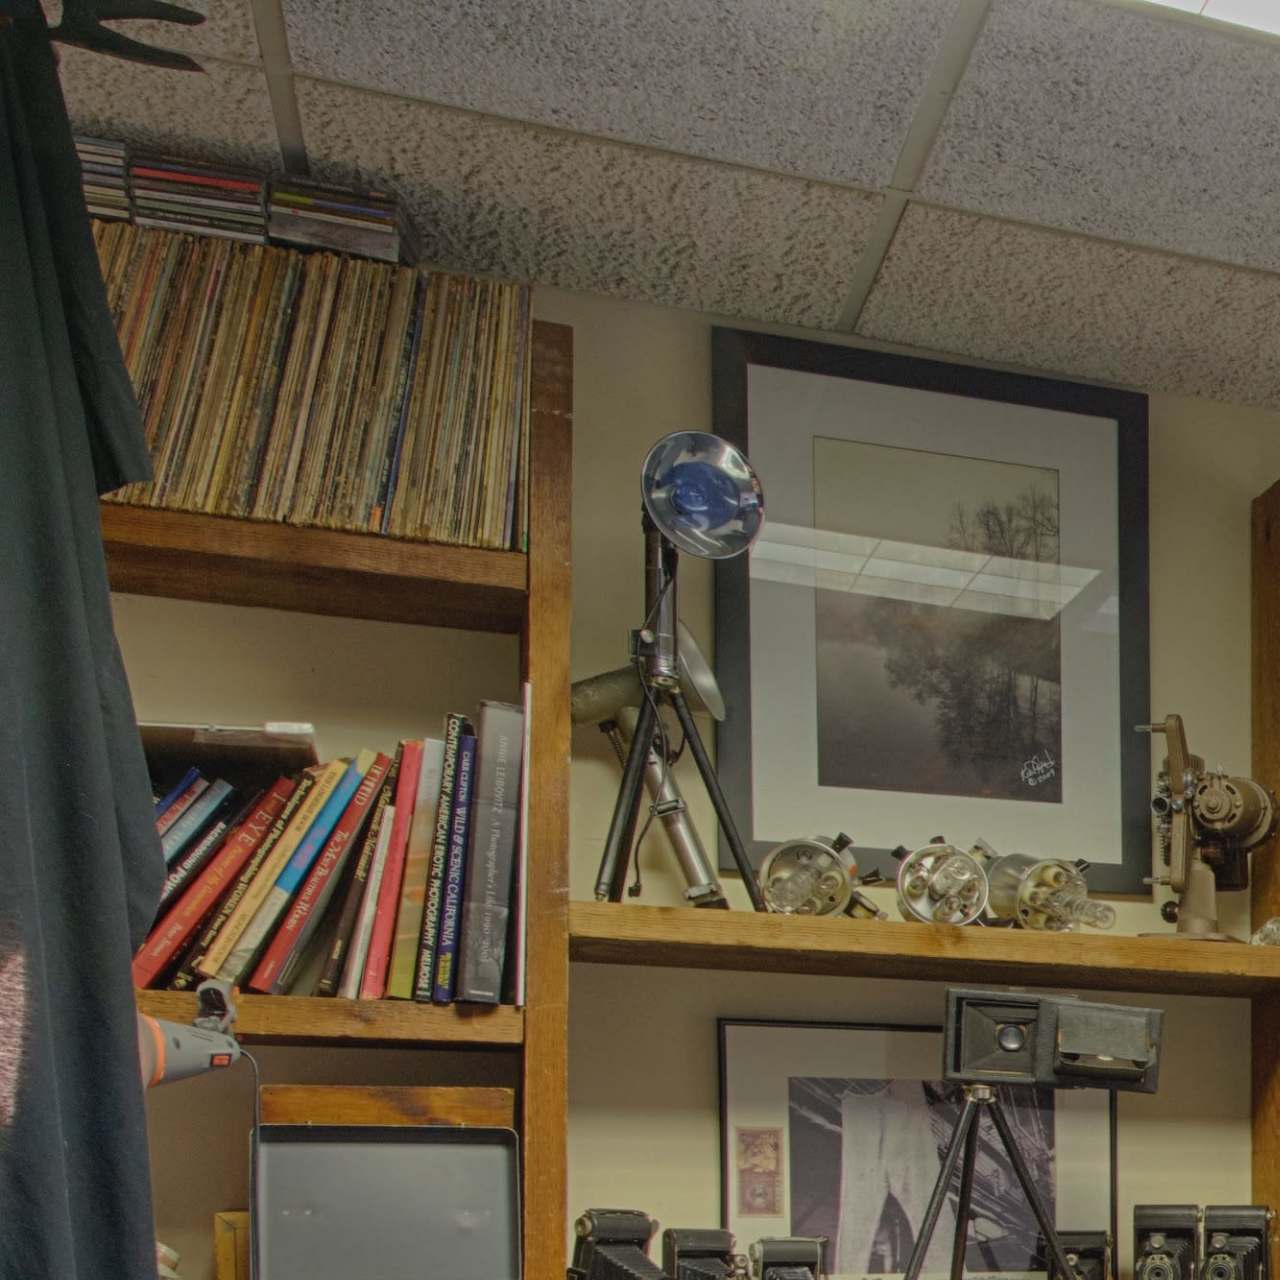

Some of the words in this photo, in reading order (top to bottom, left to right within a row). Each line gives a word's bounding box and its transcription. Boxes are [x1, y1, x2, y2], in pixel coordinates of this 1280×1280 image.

[440, 718, 459, 793] CONTEMPORARY
[491, 766, 506, 813] LEIBOVITZ
[237, 808, 272, 849] EYE
[434, 794, 450, 843] AMERICAN
[452, 806, 466, 833] WILD
[431, 844, 444, 876] EROTIC
[447, 845, 463, 883] SCENIC
[422, 878, 440, 945] PHOTOGRAPHY
[441, 883, 459, 946] CALIFORNIA
